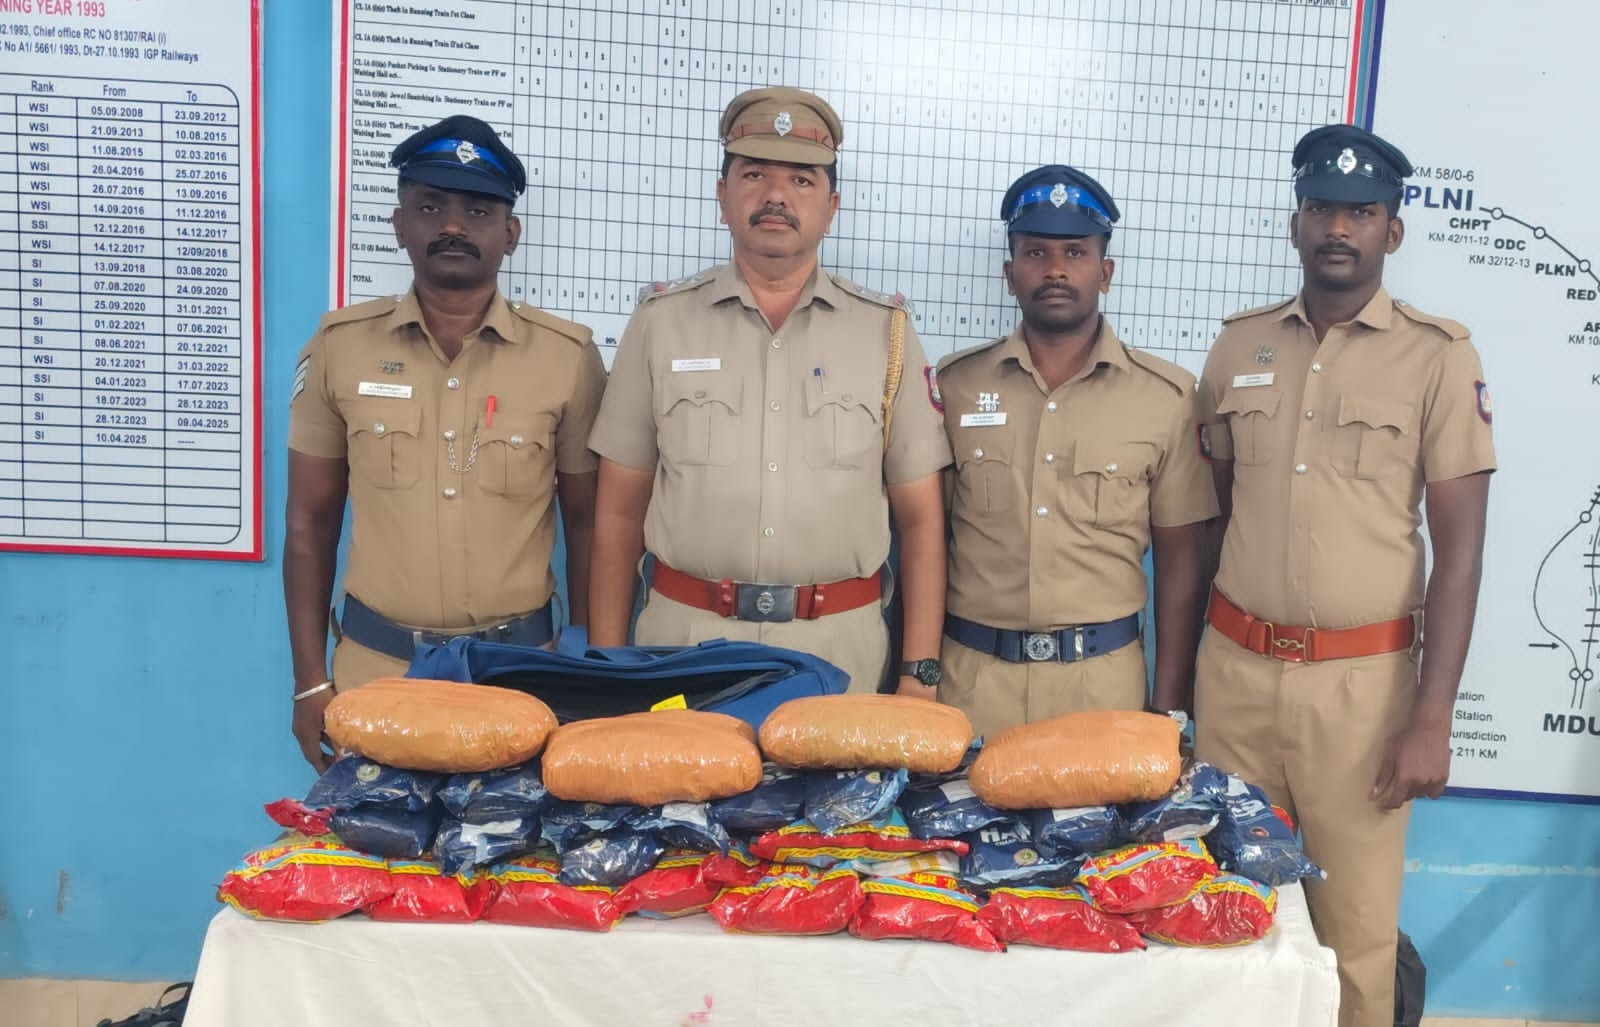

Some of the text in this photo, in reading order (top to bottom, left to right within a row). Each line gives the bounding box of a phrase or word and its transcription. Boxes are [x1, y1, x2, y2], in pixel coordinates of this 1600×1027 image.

[37, 0, 72, 16] YEAR
[76, 1, 105, 17] 1993
[33, 26, 55, 37] Chief
[58, 27, 80, 38] office
[83, 28, 96, 39] RC
[99, 29, 111, 40] NO
[4, 41, 16, 52] No
[144, 48, 159, 60] IGP
[162, 50, 198, 64] Railways
[31, 80, 198, 102] Rank From To
[29, 103, 226, 122] WSI 05.09.2008 23.09.2012
[29, 122, 226, 141] WSI 21.09.2013 10.08.2015
[30, 142, 226, 160] WSI 11.08.2015 02.03.2016
[30, 162, 50, 171] WSI
[176, 170, 227, 180] 25.07.2016
[1412, 167, 1474, 182] KM 58/0-6
[31, 181, 50, 190] WSI
[176, 189, 227, 200] 13.09.2016
[1404, 184, 1473, 211] PLNI
[31, 201, 227, 219] WSI 14.09.2016 11.12.2016
[32, 220, 227, 238] SSI 12.12.2016 14.12.2017
[1450, 218, 1491, 231] CHPT
[1428, 231, 1489, 246] KM 42/11-12
[1494, 238, 1526, 251] ODC
[32, 240, 51, 249] WSI
[94, 243, 144, 254] 14.12.2017
[32, 259, 41, 268] SI
[1469, 255, 1530, 268] KM 32/12-13
[1535, 262, 1576, 277] PLKN
[352, 275, 373, 283] TOTAL
[32, 278, 228, 296] SI 07.08.2020 24.09.2020
[1566, 288, 1597, 301] RED
[33, 297, 227, 315] SI 25.09.2020 31.01.2021
[33, 317, 42, 326] SI
[95, 320, 145, 330] 01.02.2021
[34, 336, 43, 345] SI
[177, 342, 228, 353] 20.12.2021
[1568, 334, 1584, 344] KM
[34, 355, 53, 364] WSI
[96, 358, 145, 369] 20.12.2021
[34, 374, 228, 391] SSI 04.01.2023 17.07.2023
[34, 393, 44, 401] SI
[178, 399, 228, 410] 28.12.2023
[34, 412, 44, 421] SI
[96, 415, 146, 425] 28.12.2023
[34, 431, 146, 444] SI 10.04.2025
[1457, 691, 1485, 702] ation
[1455, 710, 1493, 722] Station
[1543, 713, 1600, 736] MDU
[1456, 747, 1498, 759] 211 KM
